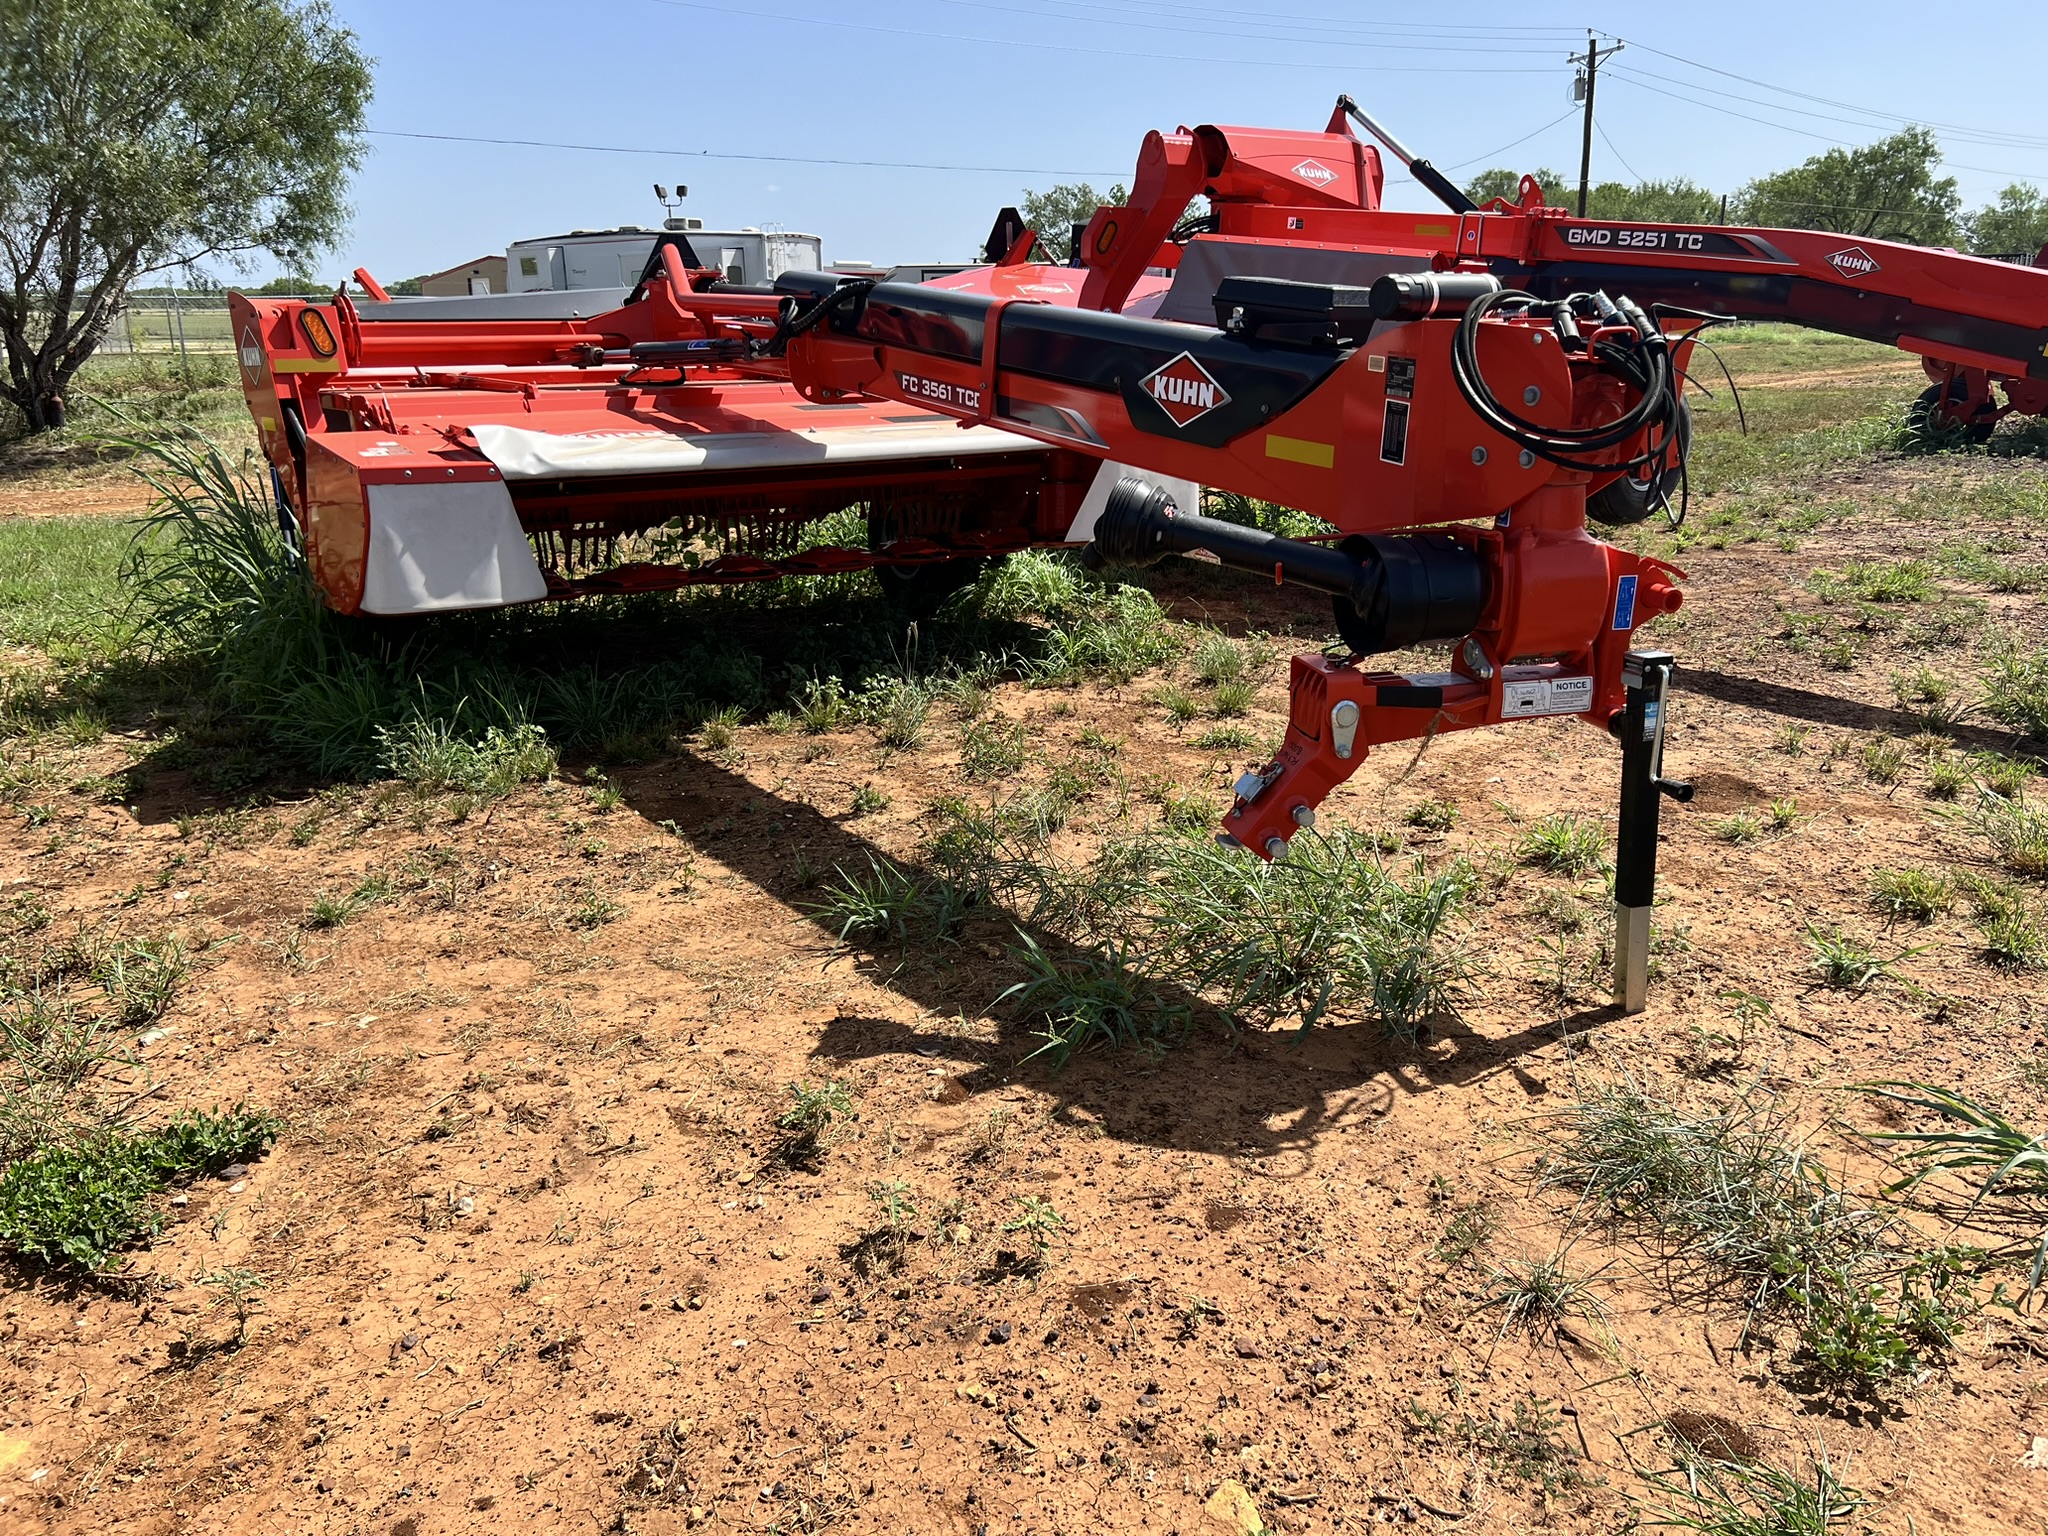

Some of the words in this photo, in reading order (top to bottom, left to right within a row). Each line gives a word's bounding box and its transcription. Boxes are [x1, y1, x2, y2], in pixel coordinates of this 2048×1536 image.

[1298, 167, 1331, 180] KUHN
[1568, 228, 1611, 245] GMD
[1617, 231, 1667, 247] 5251
[1675, 233, 1704, 250] TC
[1833, 254, 1872, 271] KUHN
[242, 347, 262, 366] KUHN
[902, 374, 918, 393] FC
[922, 379, 952, 401] 3561
[1153, 374, 1215, 409] KUHN
[1556, 681, 1587, 691] NOTICE
